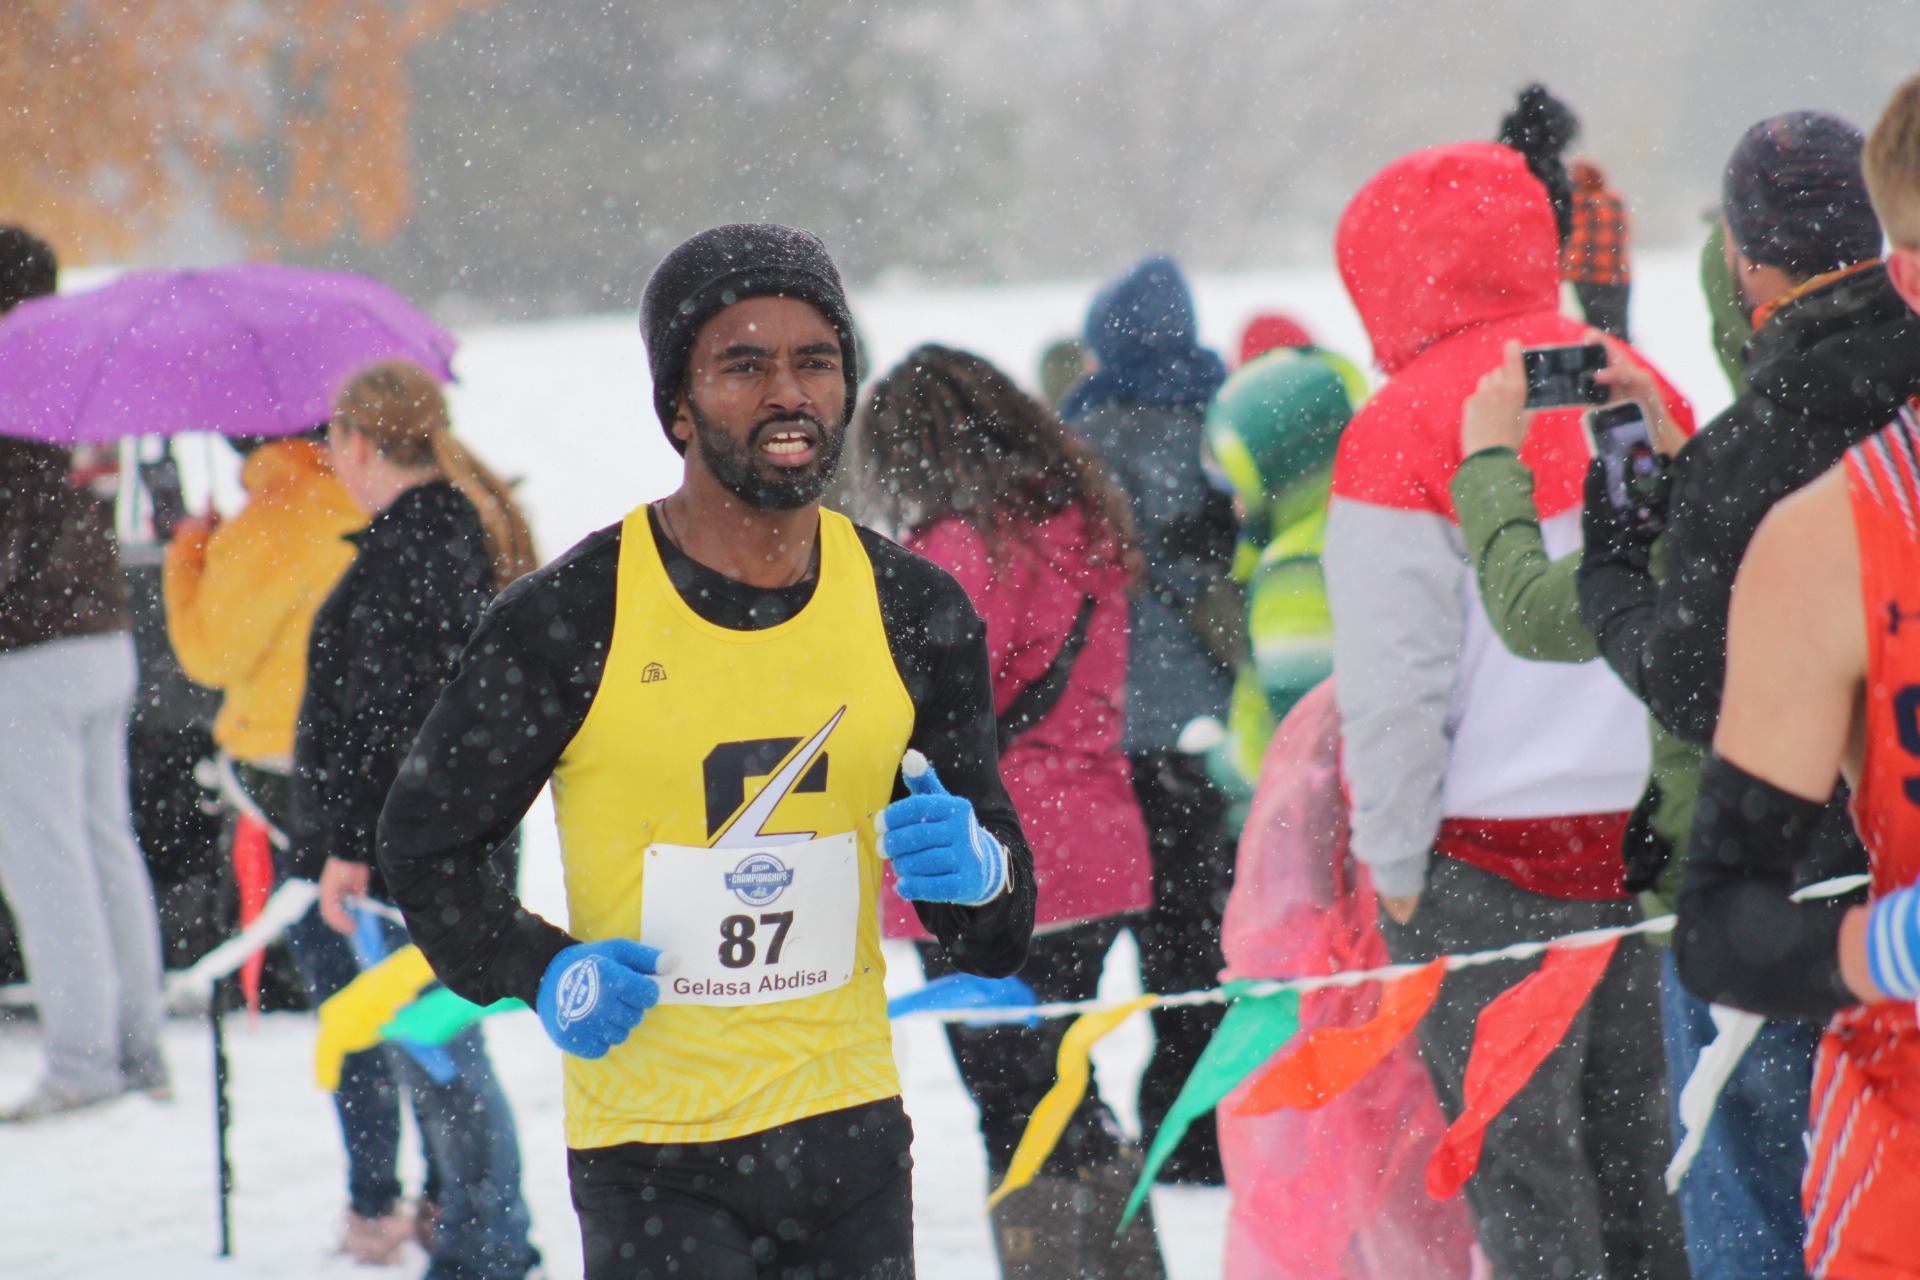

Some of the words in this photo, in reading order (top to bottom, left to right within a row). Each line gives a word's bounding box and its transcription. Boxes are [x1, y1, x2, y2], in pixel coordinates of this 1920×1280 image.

[731, 871, 788, 885] CHAMPIONSHIPS
[717, 909, 794, 969] 87
[673, 977, 751, 997] Gelasa
[757, 969, 828, 993] Abdisa
